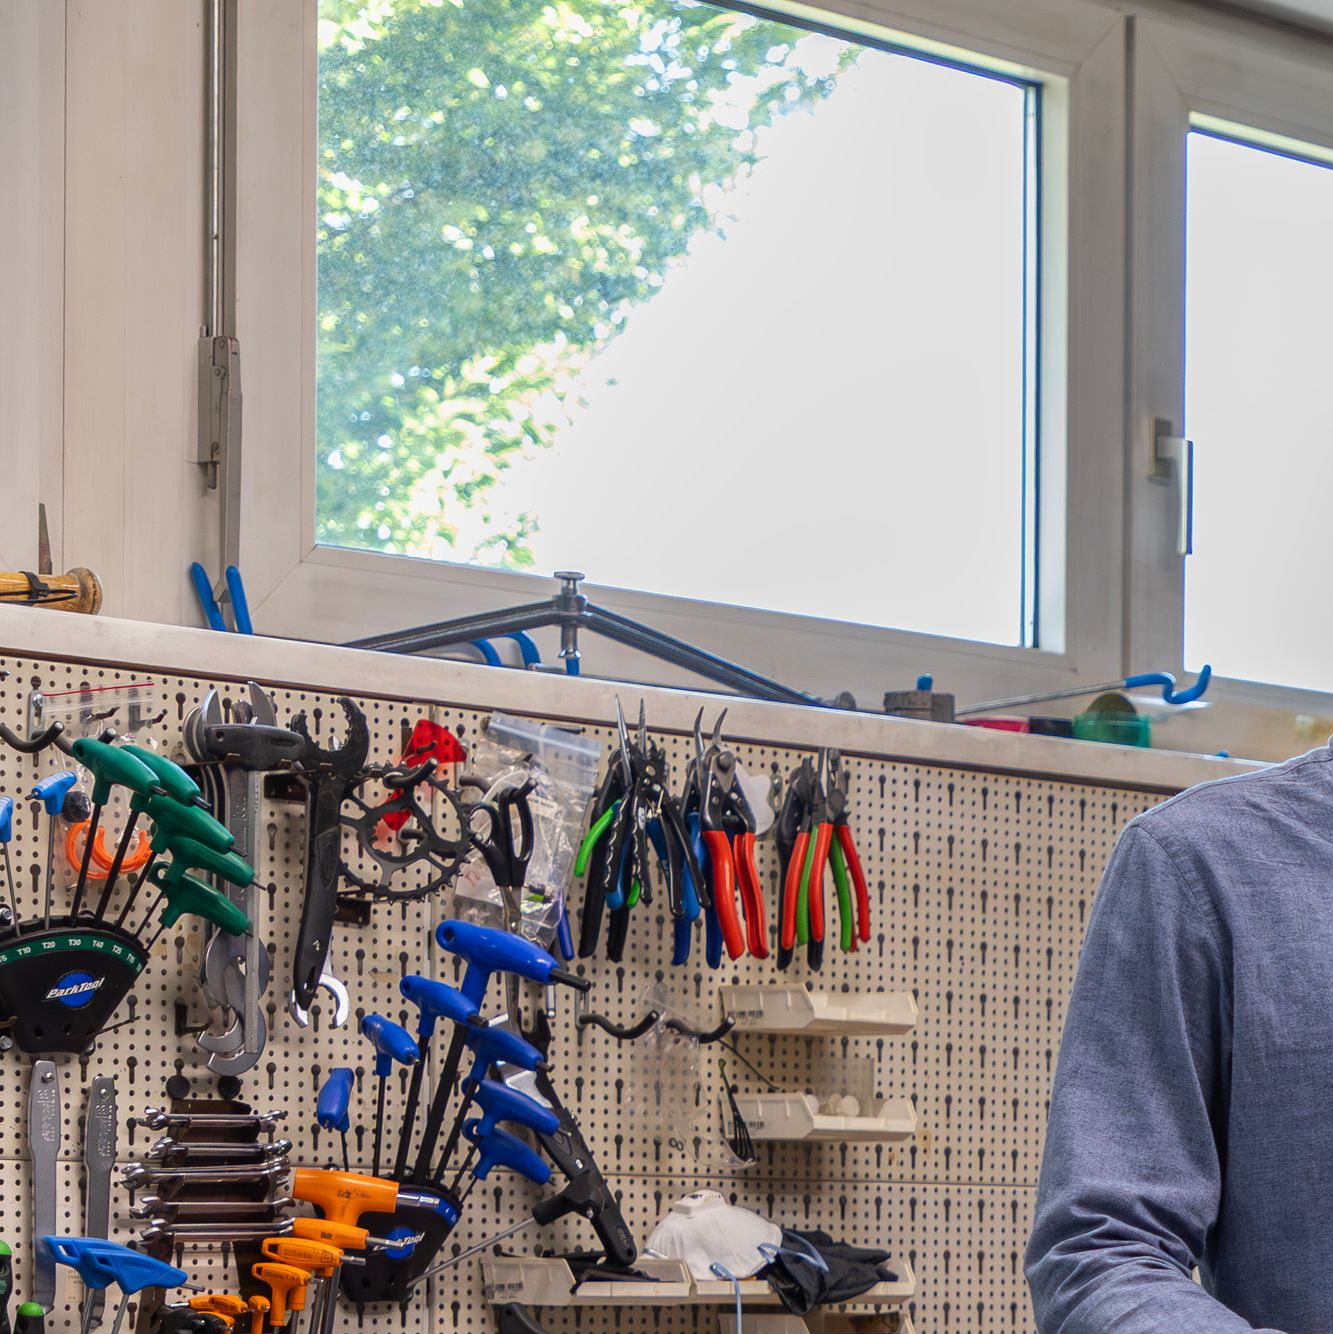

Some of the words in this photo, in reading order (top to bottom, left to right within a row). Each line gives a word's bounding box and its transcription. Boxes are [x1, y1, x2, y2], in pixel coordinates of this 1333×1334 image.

[17, 946, 31, 955] T10
[42, 940, 56, 949] T20
[68, 938, 82, 946] T30
[92, 939, 104, 949] T40
